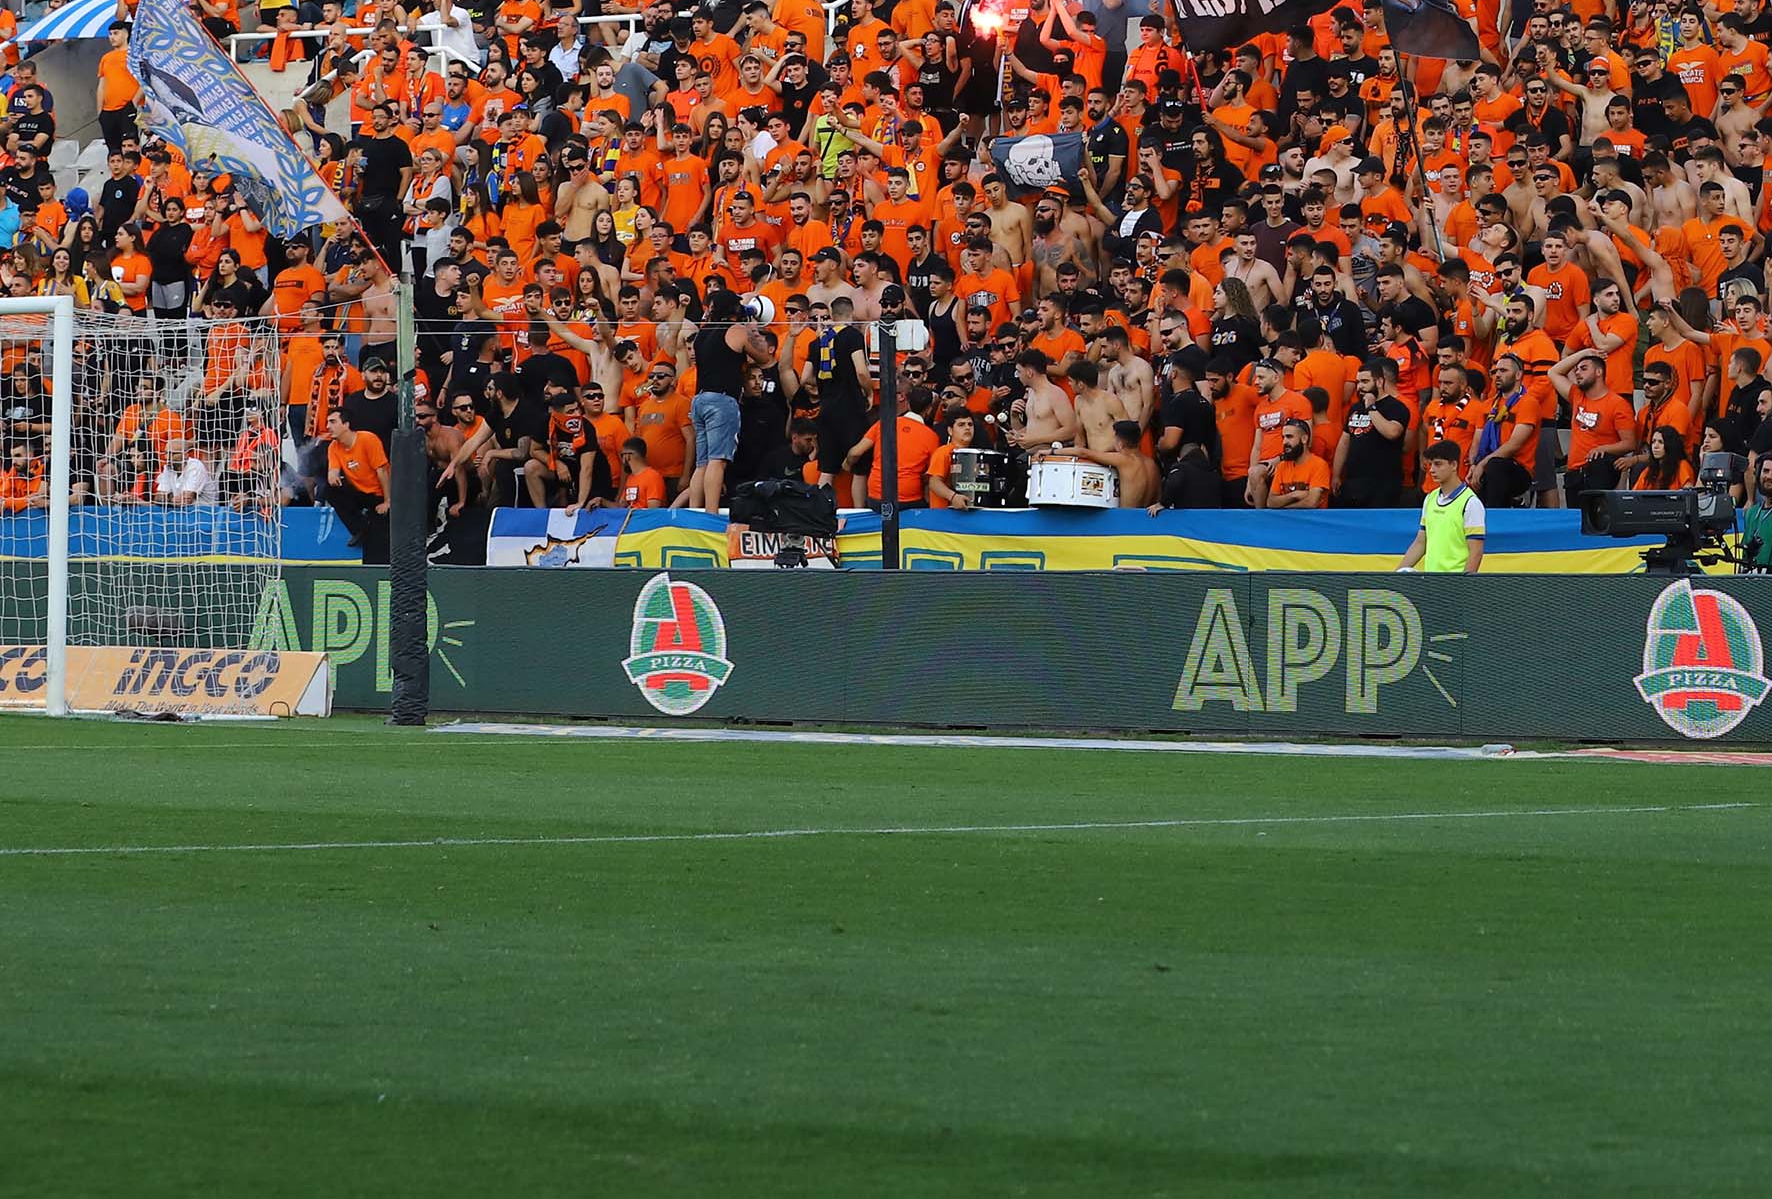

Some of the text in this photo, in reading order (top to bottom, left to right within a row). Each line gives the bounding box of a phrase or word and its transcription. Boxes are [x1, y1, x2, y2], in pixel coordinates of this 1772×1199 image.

[1172, 588, 1424, 714] APP
[650, 656, 708, 671] PIZZA
[1669, 671, 1738, 690] PIZZA
